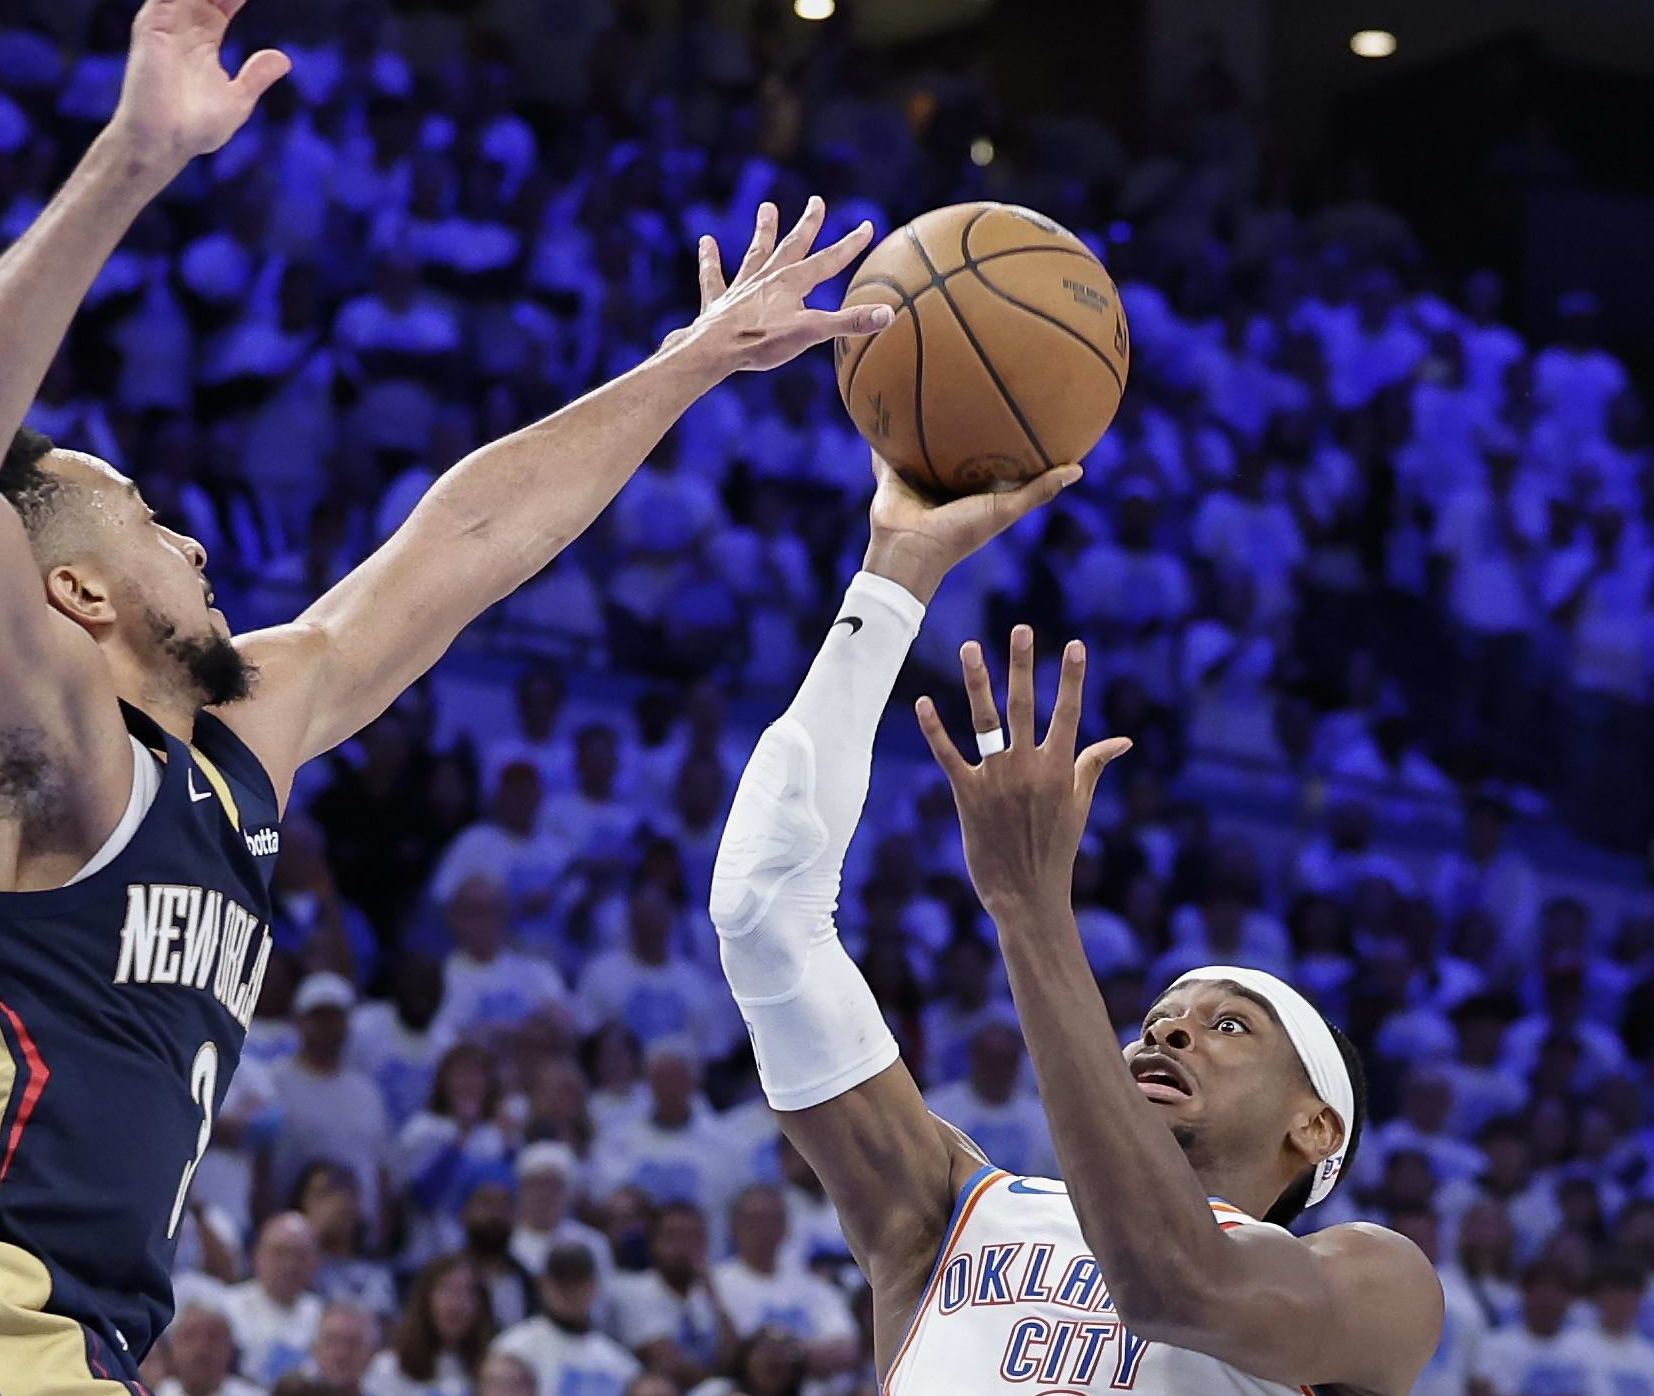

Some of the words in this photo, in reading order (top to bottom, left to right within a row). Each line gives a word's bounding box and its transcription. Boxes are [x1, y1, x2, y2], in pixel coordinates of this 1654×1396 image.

[114, 884, 223, 990] NEW
[938, 1242, 1117, 1316] OKLA
[1000, 1317, 1150, 1390] CITY
